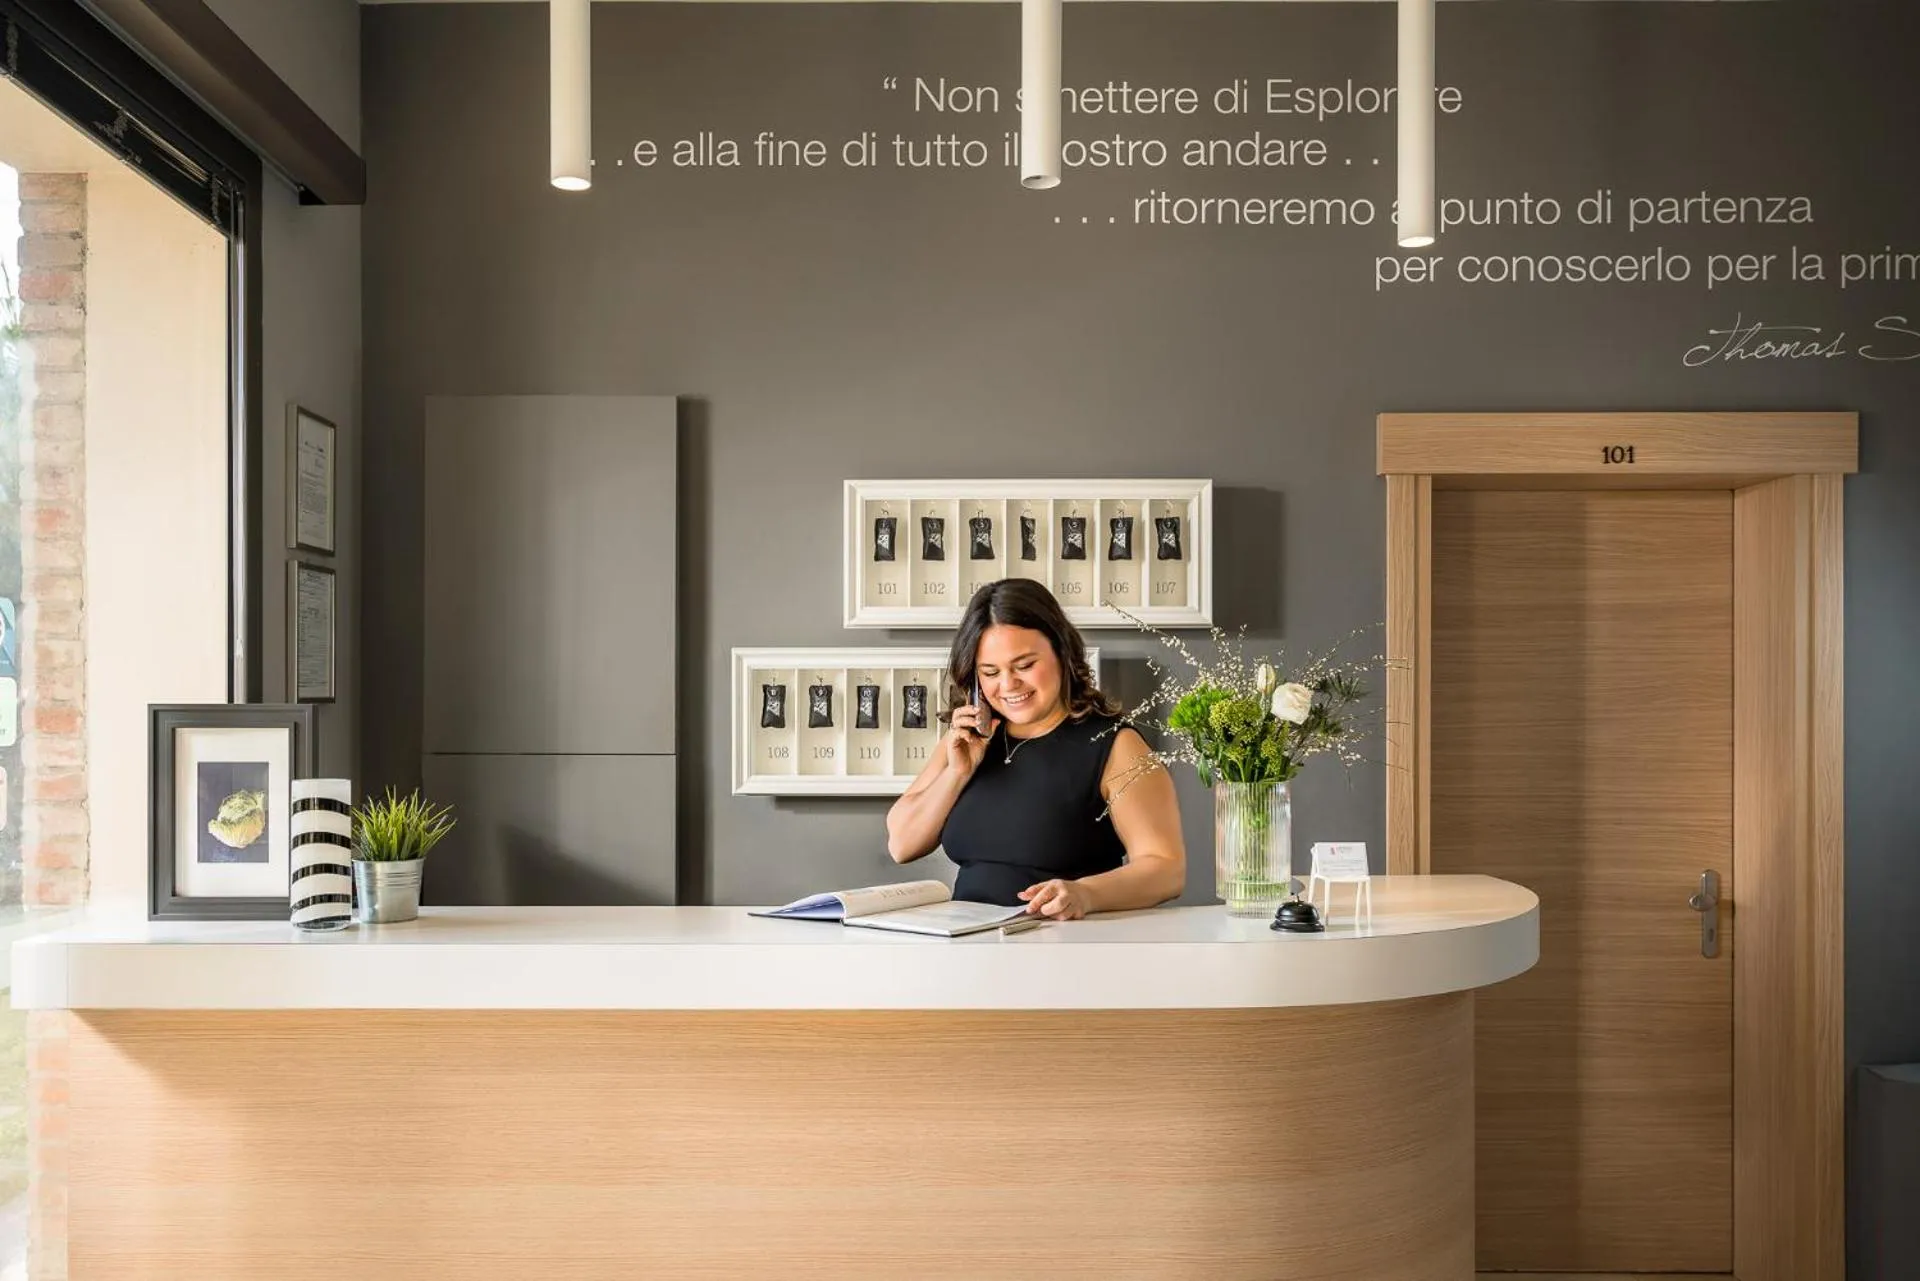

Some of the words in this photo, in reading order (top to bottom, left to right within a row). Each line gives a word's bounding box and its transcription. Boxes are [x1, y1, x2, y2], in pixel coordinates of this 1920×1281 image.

[916, 78, 998, 112] Non
[1214, 79, 1247, 114] di
[1267, 79, 1462, 121] Esplore
[673, 132, 740, 166] alla
[754, 132, 826, 166] fine
[843, 132, 876, 166] di
[892, 134, 987, 166] tutto
[1005, 132, 1018, 166] il
[1061, 134, 1167, 166] ostro
[1183, 132, 1326, 166] andare
[1135, 189, 1375, 225] ritorneremo
[1441, 193, 1560, 233] punto
[1577, 190, 1611, 224] di
[1630, 191, 1813, 232] partenza
[1376, 256, 1443, 291] per
[1458, 247, 1690, 282] conoscerlo
[1708, 255, 1776, 289] per
[1793, 246, 1825, 280] la
[1683, 312, 1845, 366] Thomas
[1601, 445, 1635, 464] 101
[877, 583, 897, 595] 101
[923, 583, 945, 595] 102
[1061, 582, 1082, 594] 105
[1109, 582, 1129, 593] 106
[1155, 582, 1176, 593] 107
[768, 747, 789, 759] 108
[813, 747, 834, 758] 109
[860, 747, 880, 759] 110
[906, 747, 925, 759] 111
